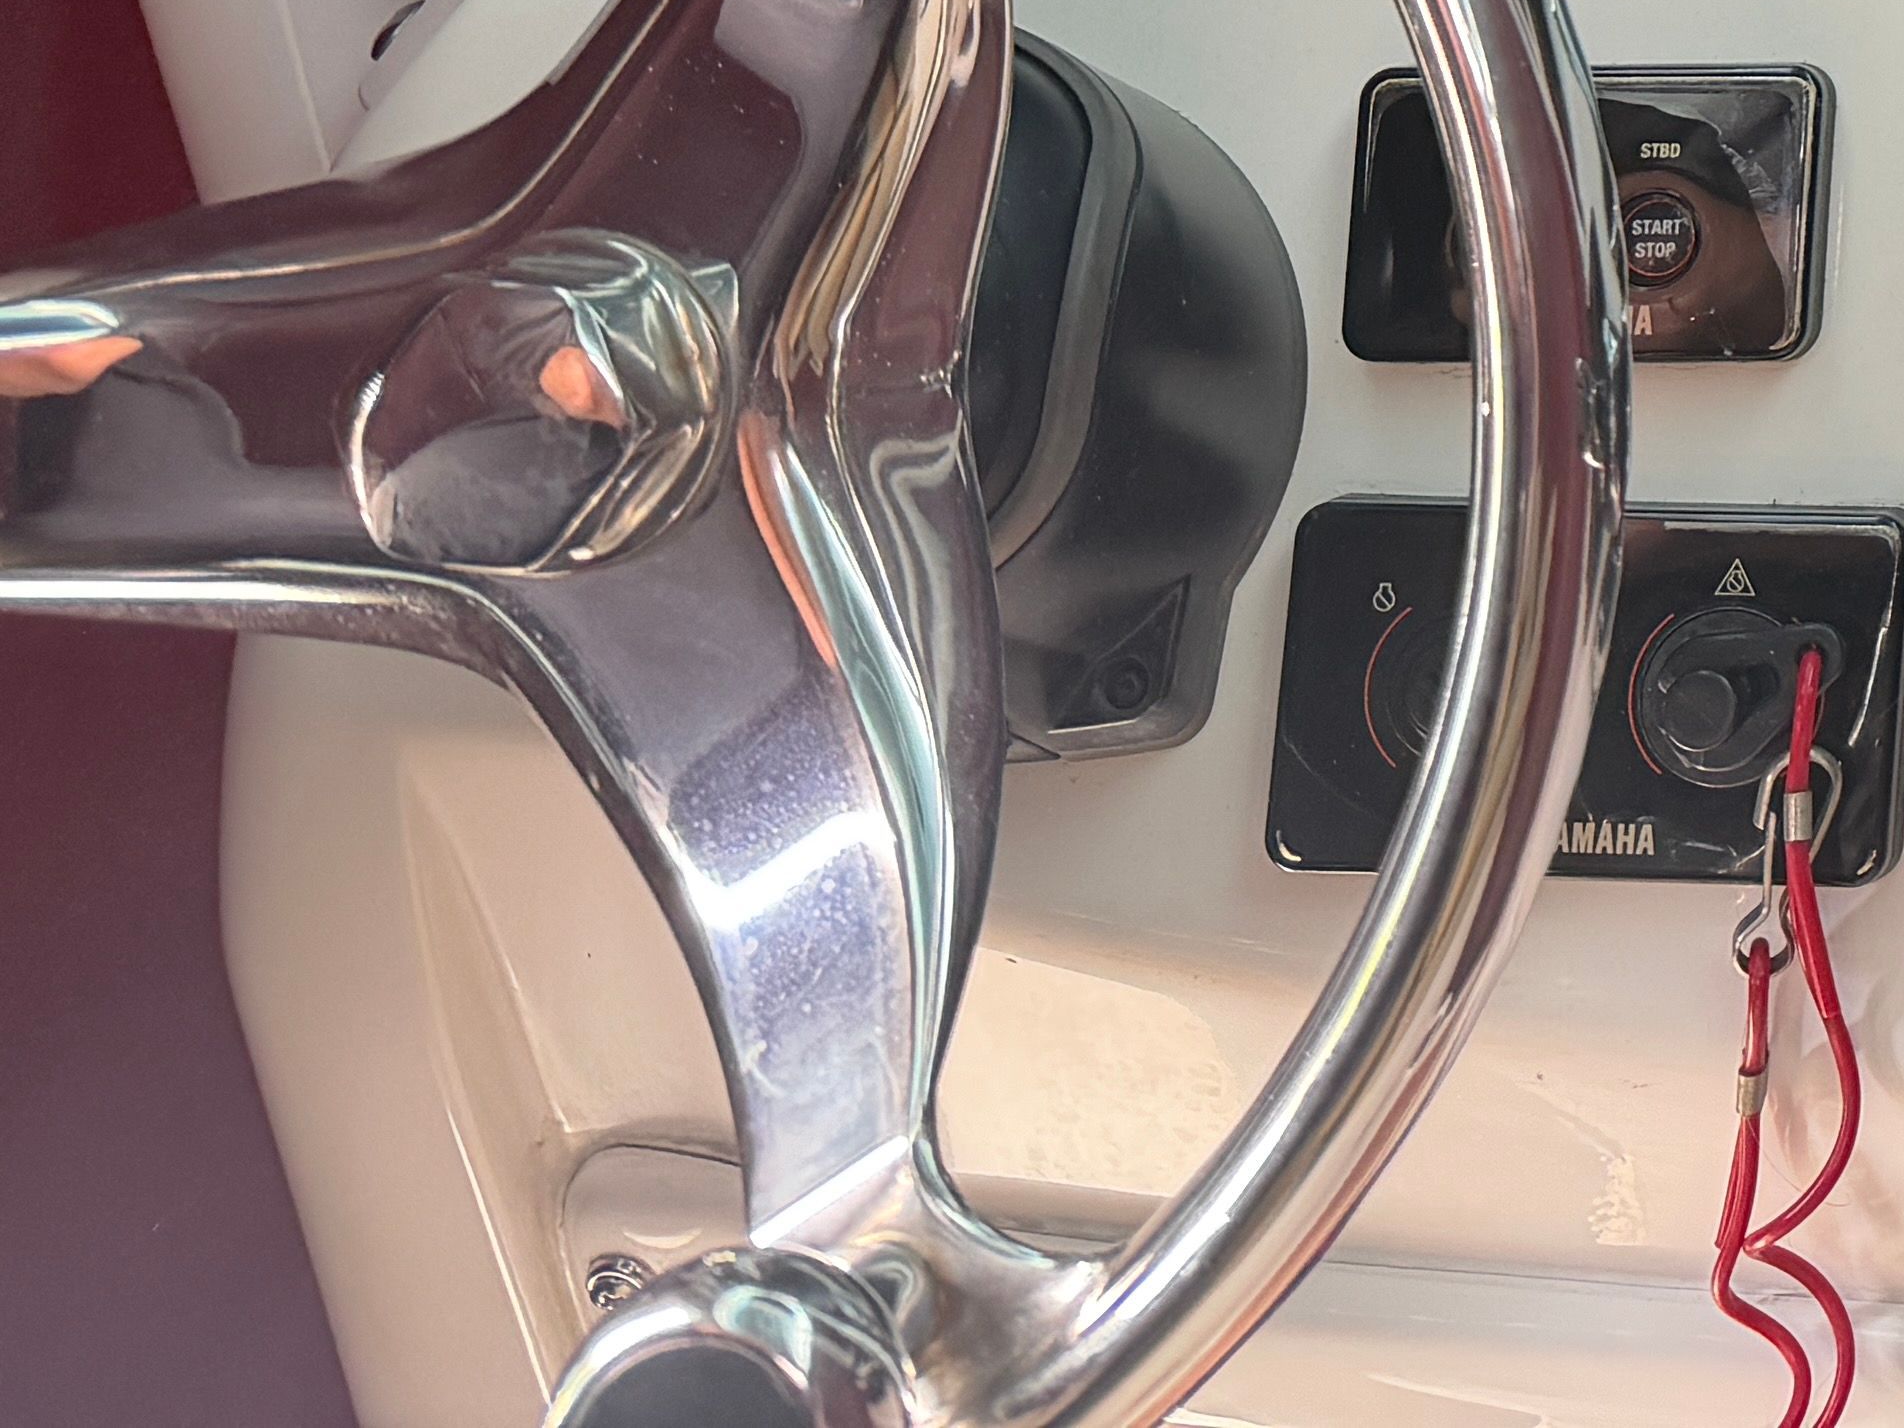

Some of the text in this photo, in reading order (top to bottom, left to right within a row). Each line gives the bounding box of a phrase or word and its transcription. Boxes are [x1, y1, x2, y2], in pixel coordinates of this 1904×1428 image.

[1640, 143, 1681, 158] STBD
[1632, 219, 1680, 235] START
[1635, 243, 1676, 258] STOP
[1557, 821, 1655, 855] AMAHA
